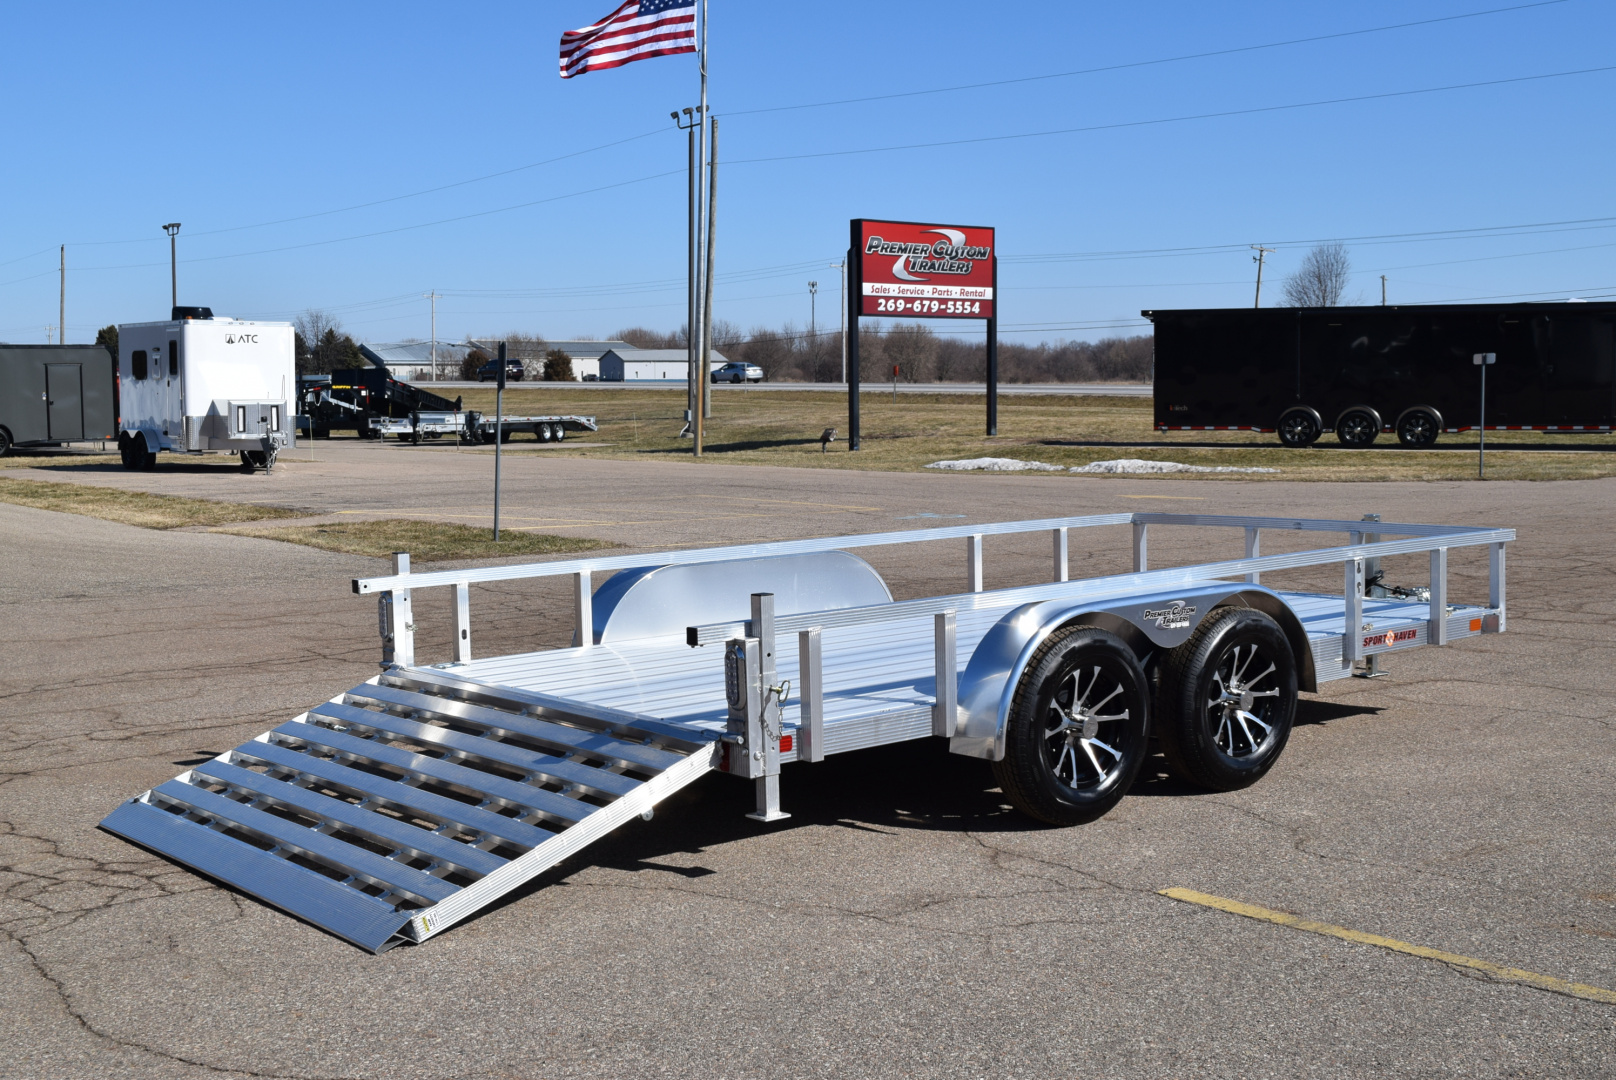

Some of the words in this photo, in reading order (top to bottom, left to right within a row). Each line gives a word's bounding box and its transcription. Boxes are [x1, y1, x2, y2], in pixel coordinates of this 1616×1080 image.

[865, 236, 931, 257] PREMIER
[932, 240, 991, 261] CUSTOM
[909, 255, 973, 275] TRAILERS
[871, 285, 890, 294] Sales
[897, 286, 925, 296] Service
[932, 287, 953, 297] Parts
[960, 288, 986, 298] Rental
[877, 299, 981, 314] 269-679-5554
[237, 334, 259, 344] ATC
[1143, 609, 1172, 620] PREMIER
[1362, 634, 1387, 647] SPORT
[1393, 629, 1418, 642] HAVEN
